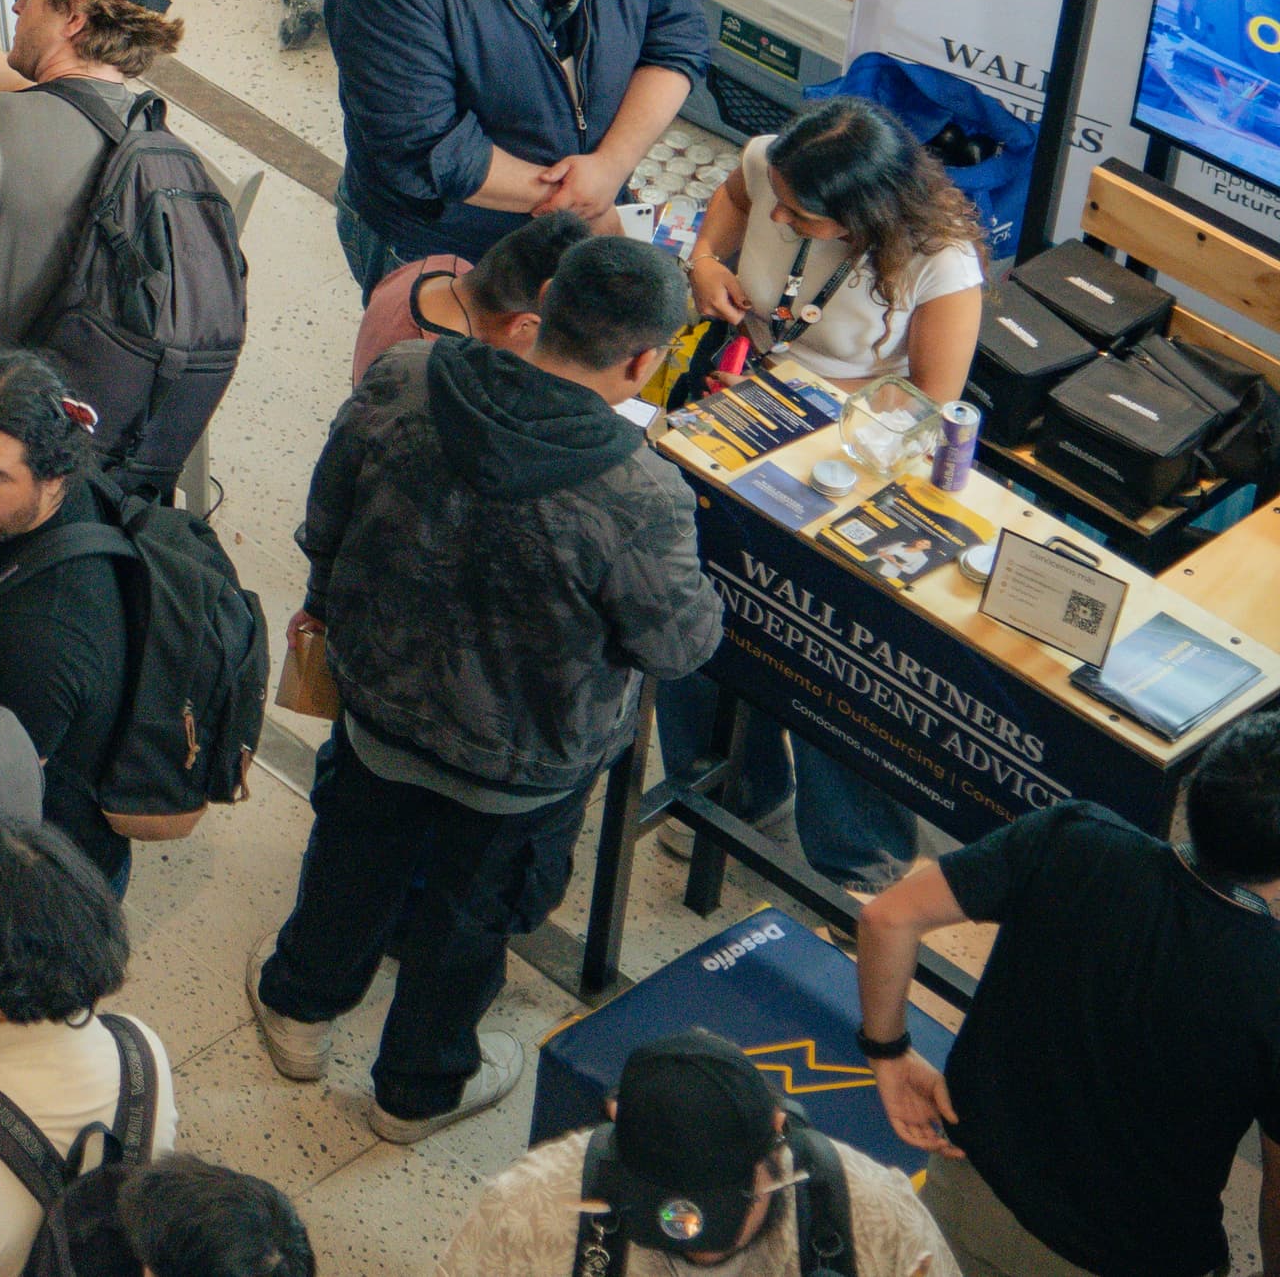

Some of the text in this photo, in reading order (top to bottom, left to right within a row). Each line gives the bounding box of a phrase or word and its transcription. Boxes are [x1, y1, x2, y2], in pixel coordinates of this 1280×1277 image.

[724, 625, 945, 780] clutamiento Outsourcing
[741, 551, 1045, 764] WALL PARTNERS
[791, 697, 955, 811] Conócenos en www.wp.cl
